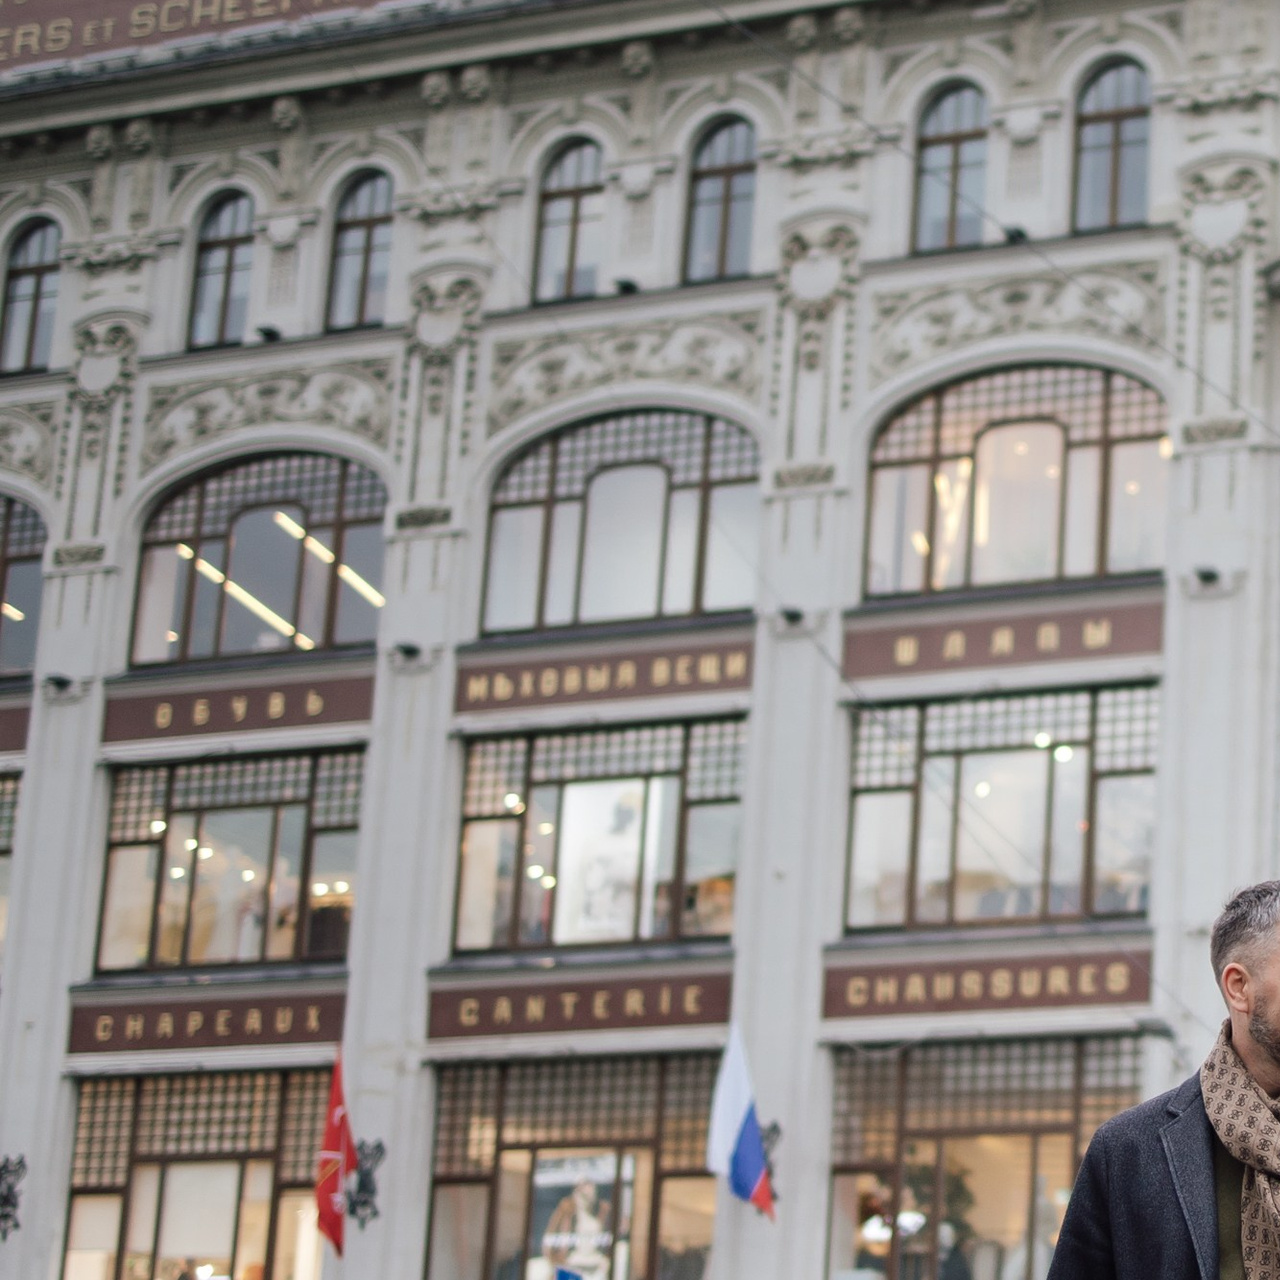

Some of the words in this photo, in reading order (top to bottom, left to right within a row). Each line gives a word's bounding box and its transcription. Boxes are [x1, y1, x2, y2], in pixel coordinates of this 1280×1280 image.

[650, 651, 748, 687] ВЕЩИ
[154, 690, 325, 730] ОБУВЬ
[845, 962, 1131, 1008] CHAUSSURES
[94, 1004, 321, 1043] CHAPEAUX
